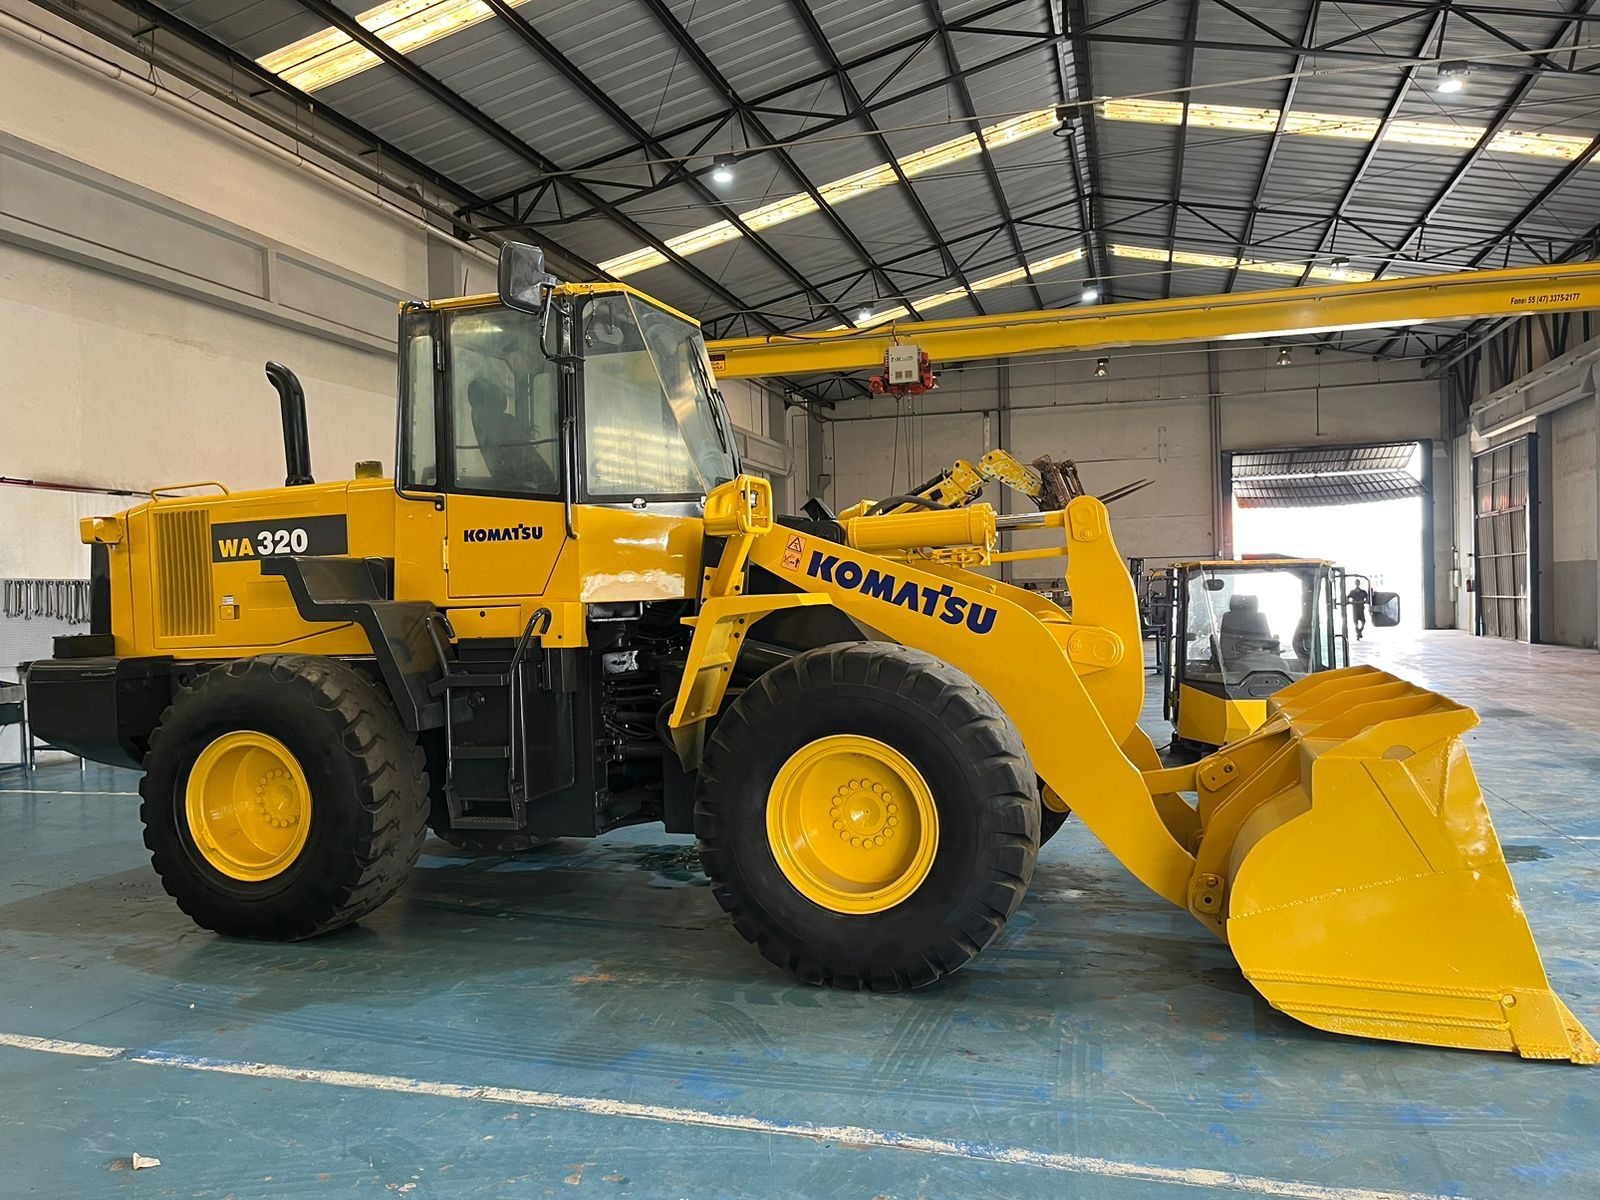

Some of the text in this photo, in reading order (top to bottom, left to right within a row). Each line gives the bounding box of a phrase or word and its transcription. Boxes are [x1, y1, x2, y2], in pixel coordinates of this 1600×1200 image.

[1528, 296, 1535, 304] 55
[1536, 295, 1549, 304] (47)
[1549, 293, 1580, 302] 3375-2177
[218, 528, 308, 558] WA 320
[463, 523, 543, 542] KOMATSU
[806, 550, 998, 634] KOMATSU
